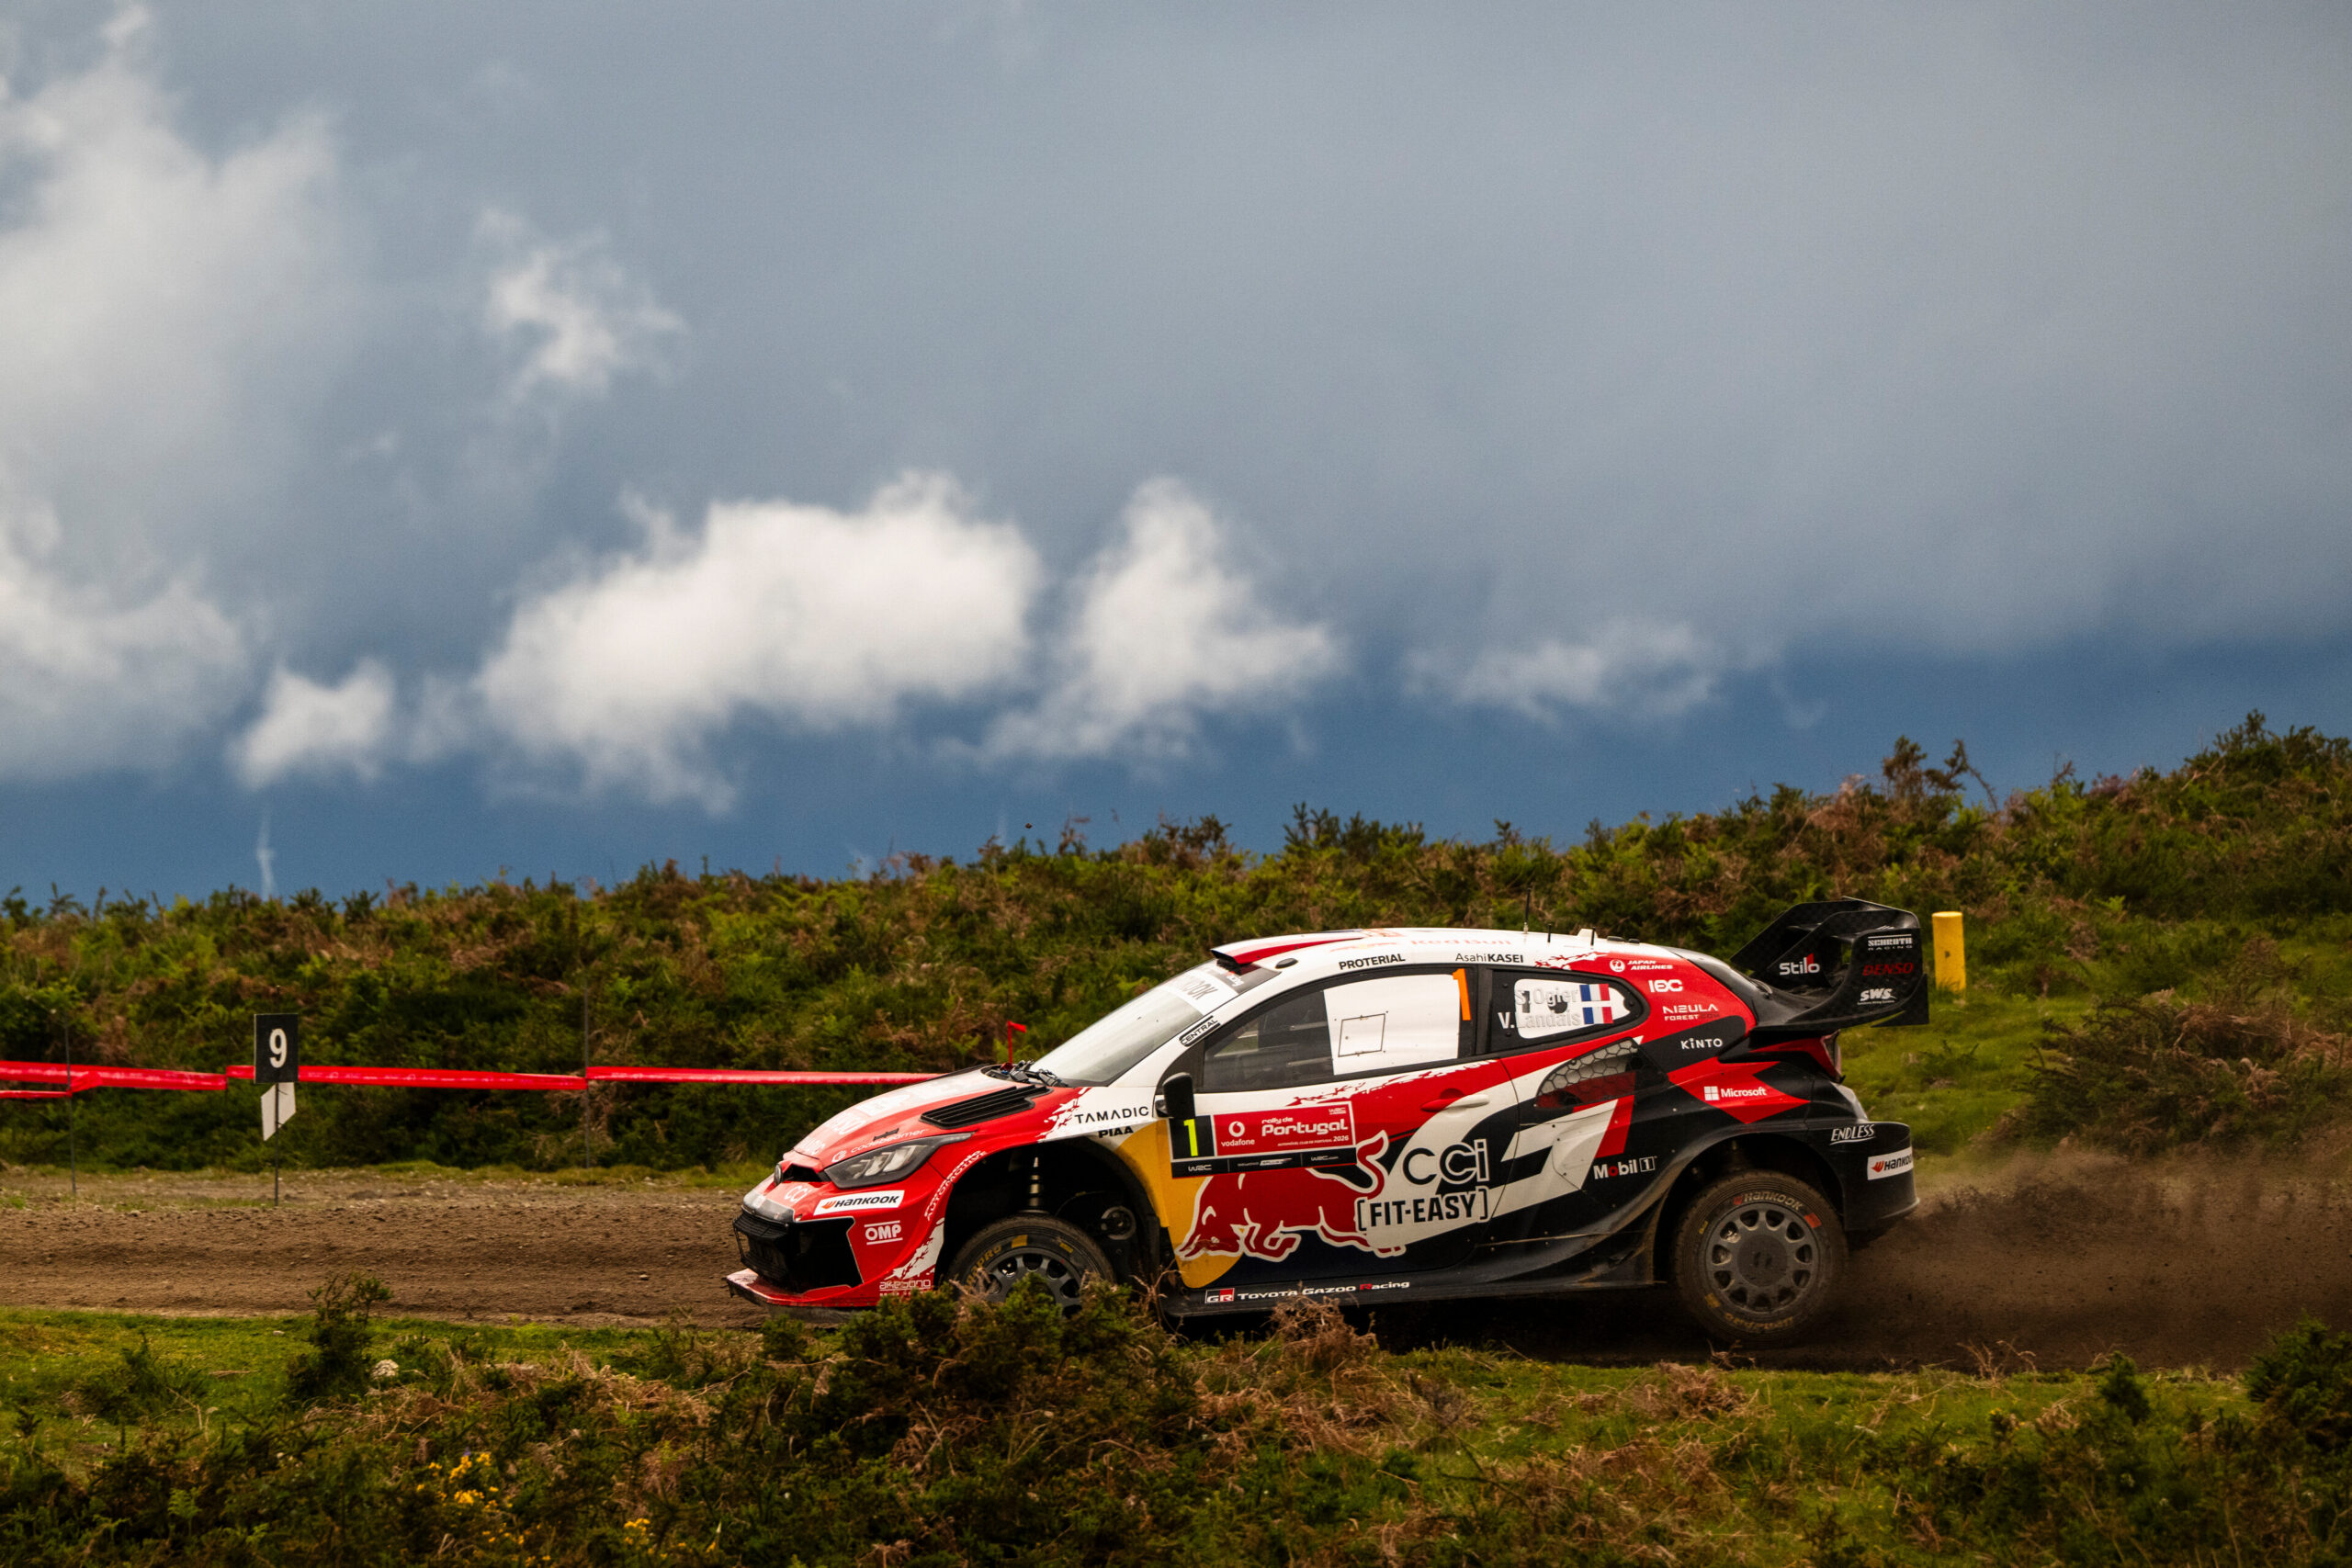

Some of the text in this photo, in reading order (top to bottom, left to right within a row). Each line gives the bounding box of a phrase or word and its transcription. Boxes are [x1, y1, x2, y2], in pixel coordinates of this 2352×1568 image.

[1339, 953, 1407, 970] PROTERIAL
[1779, 953, 1821, 976] Stilo
[1862, 963, 1914, 976] DENSO
[1453, 968, 1472, 1021] 1
[1860, 987, 1894, 1002] SWS
[1181, 1019, 1218, 1045] CENTRAL
[268, 1028, 288, 1068] 9
[1721, 1087, 1768, 1098] Microsoft
[1074, 1106, 1149, 1123] TAMADIC
[1098, 1126, 1134, 1138] PIAA
[1261, 1119, 1349, 1136] Portugal
[1830, 1123, 1874, 1142] ENDLESS
[1183, 1119, 1198, 1156] 1
[1221, 1137, 1255, 1147] vodafone
[1593, 1159, 1638, 1179] Mobil
[865, 1224, 902, 1241] OMP
[1206, 1280, 1410, 1303] GR TOYOTA GAZOO Racing
